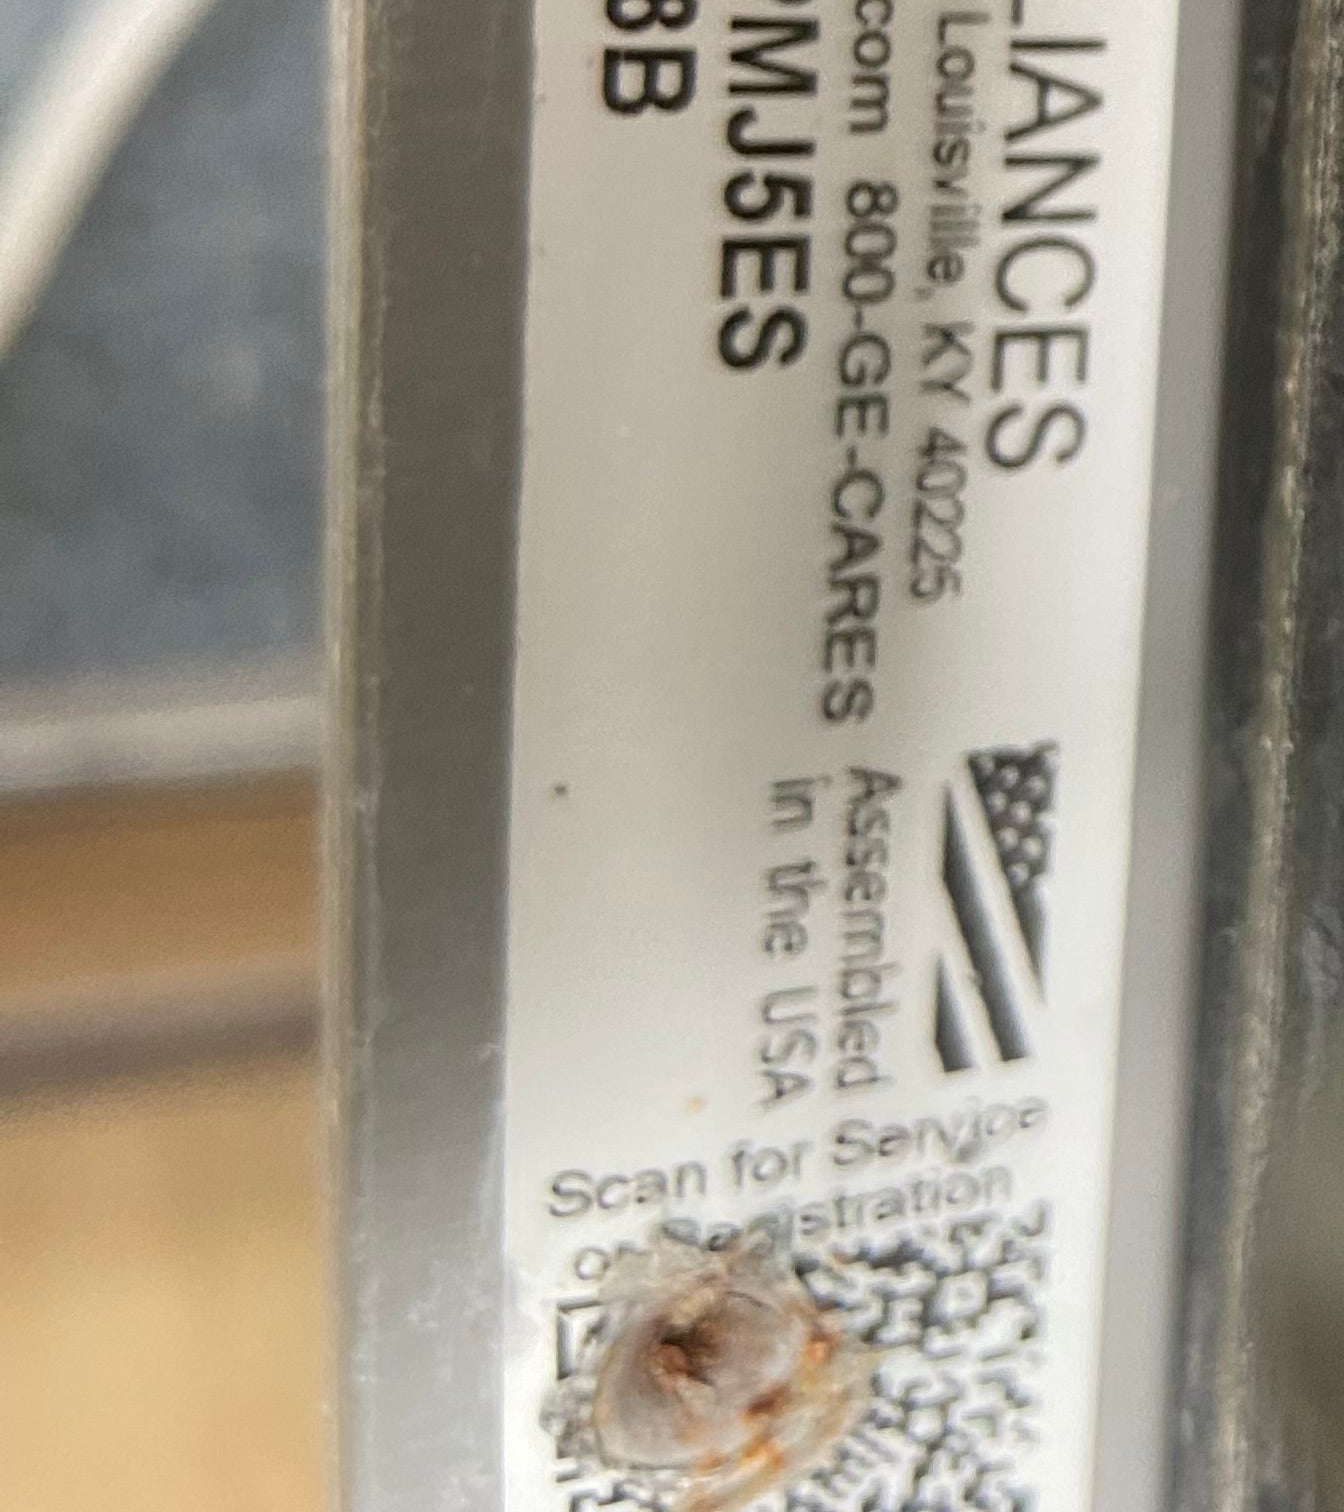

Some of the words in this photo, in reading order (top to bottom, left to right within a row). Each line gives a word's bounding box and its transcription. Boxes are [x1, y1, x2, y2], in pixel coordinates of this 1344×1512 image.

[918, 10, 990, 301] Louisville,
[920, 322, 973, 407] KY
[820, 180, 898, 726] 800-GE-CARES
[905, 427, 968, 601] 40225
[768, 775, 833, 834] in
[760, 860, 828, 958] the
[829, 765, 902, 1090] Assembled
[757, 986, 816, 1112] USA
[547, 1161, 708, 1218] Scan
[730, 1143, 812, 1190] for
[832, 1096, 1050, 1168] Service
